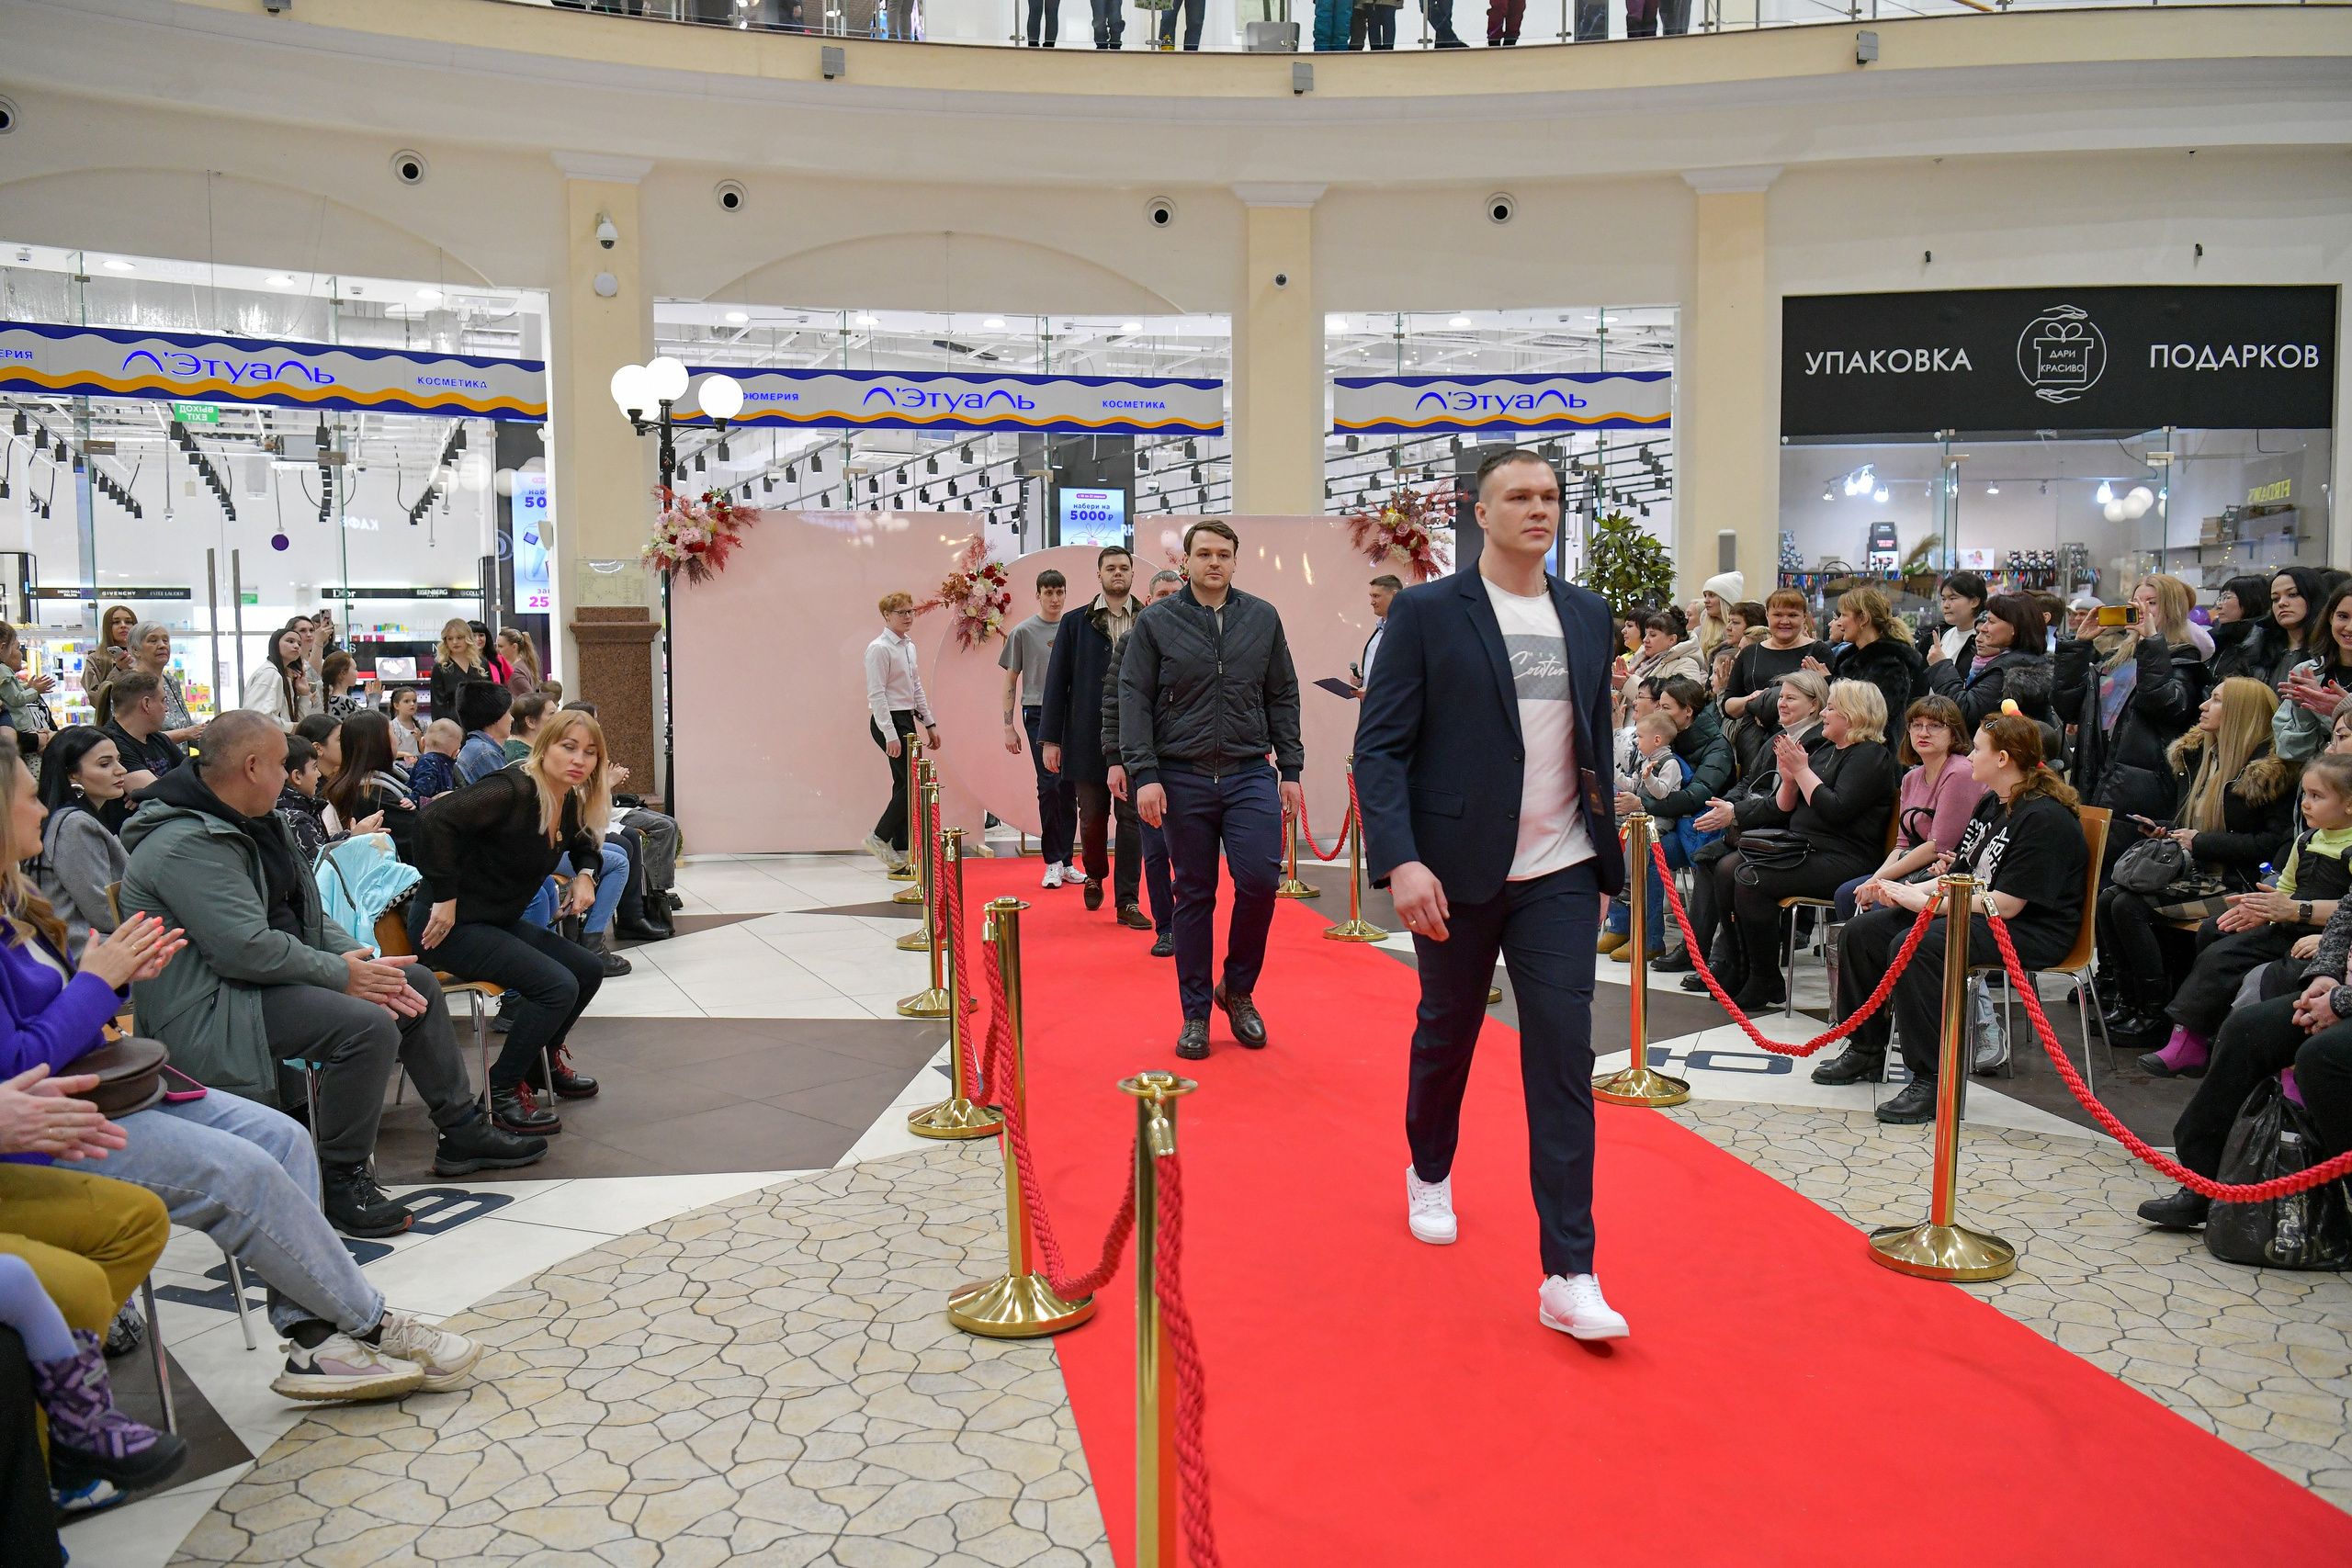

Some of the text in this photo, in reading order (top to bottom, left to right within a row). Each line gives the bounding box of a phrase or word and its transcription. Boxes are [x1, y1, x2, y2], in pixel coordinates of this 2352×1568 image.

[2049, 349, 2076, 359] ДАРИ
[2150, 344, 2320, 371] ПОДАРКОВ
[1804, 347, 1973, 376] УПАКОВКА
[2040, 364, 2085, 373] КРАСИВО
[416, 376, 488, 389] КОСМЕТИКА
[1102, 400, 1166, 410] КОСМЕТИКА
[1073, 502, 1100, 511] набери
